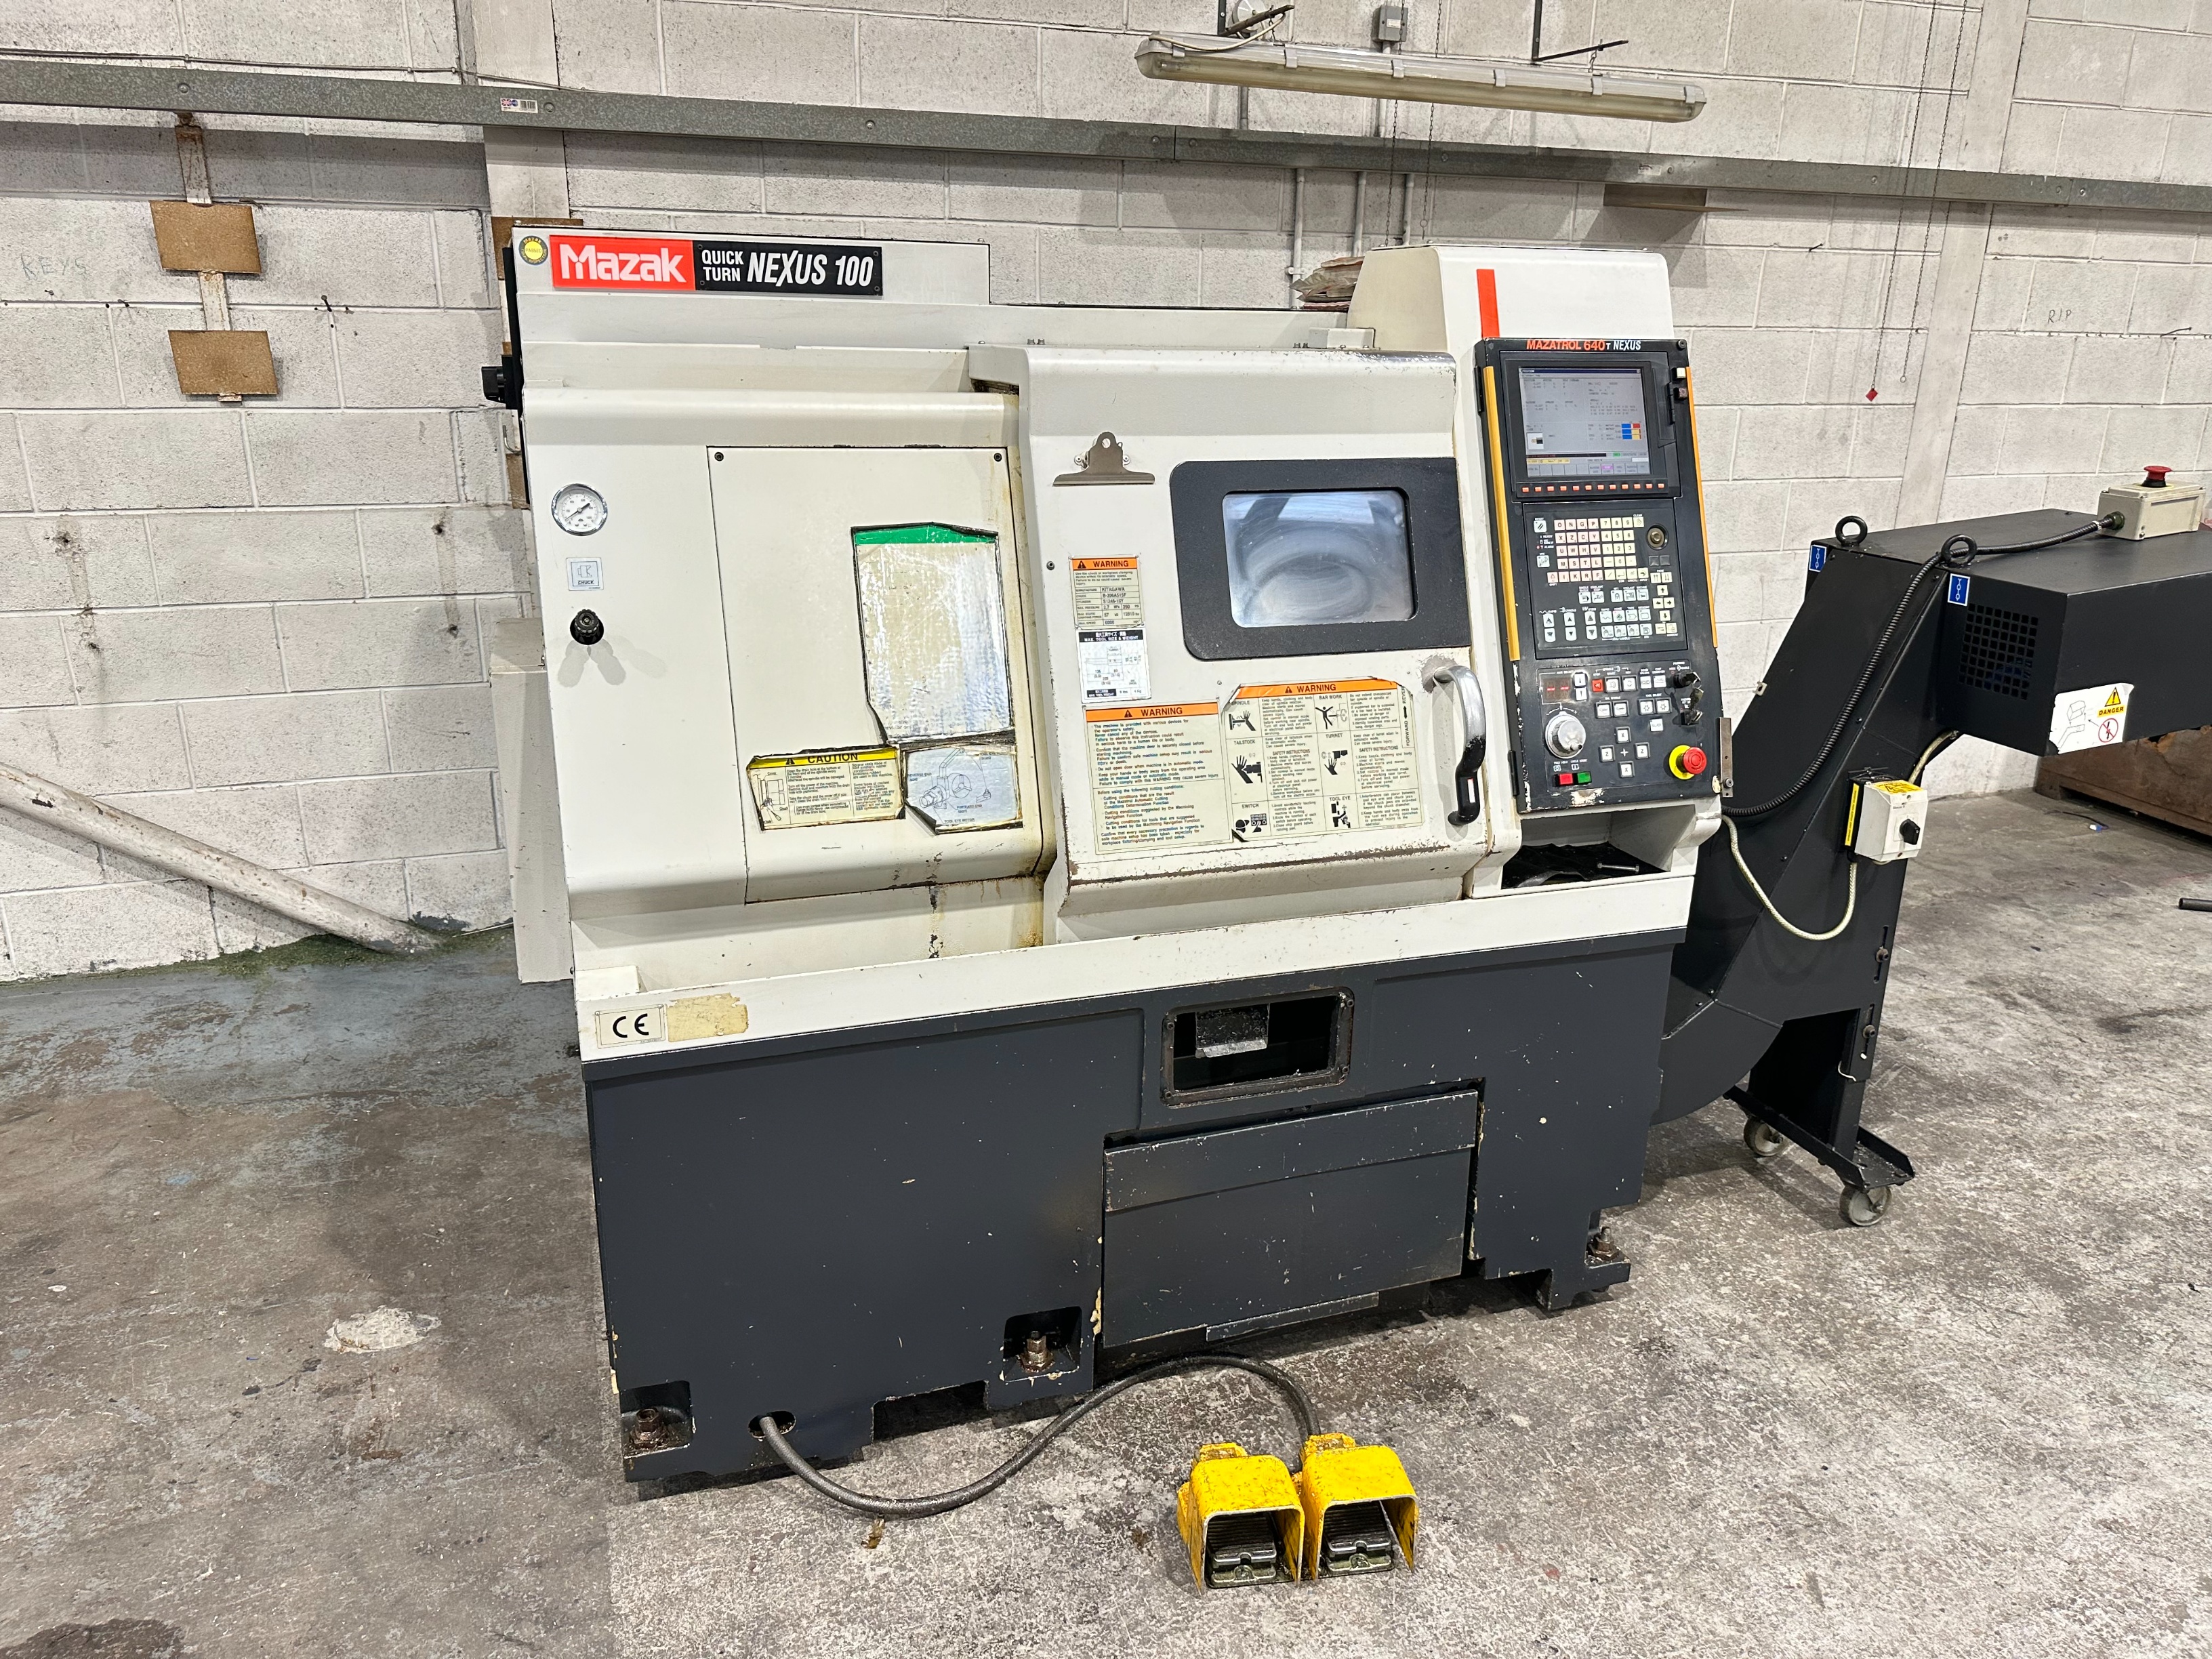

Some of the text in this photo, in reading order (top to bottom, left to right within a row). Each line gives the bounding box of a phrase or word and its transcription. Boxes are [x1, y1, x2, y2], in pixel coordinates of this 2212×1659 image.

[560, 243, 687, 283] Mazak
[701, 249, 744, 266] QUICK
[703, 266, 741, 282] TURN
[747, 250, 874, 287] NEXUS 100
[2047, 308, 2072, 324] RIP
[1526, 340, 1581, 350] MAZATROL
[1614, 340, 1641, 350] NEXUS
[1297, 684, 1336, 693] WARNING
[1141, 708, 1183, 716] WARNING
[2099, 707, 2124, 716] DANGER
[808, 753, 858, 763] CAUTION
[613, 1013, 649, 1038] CE
